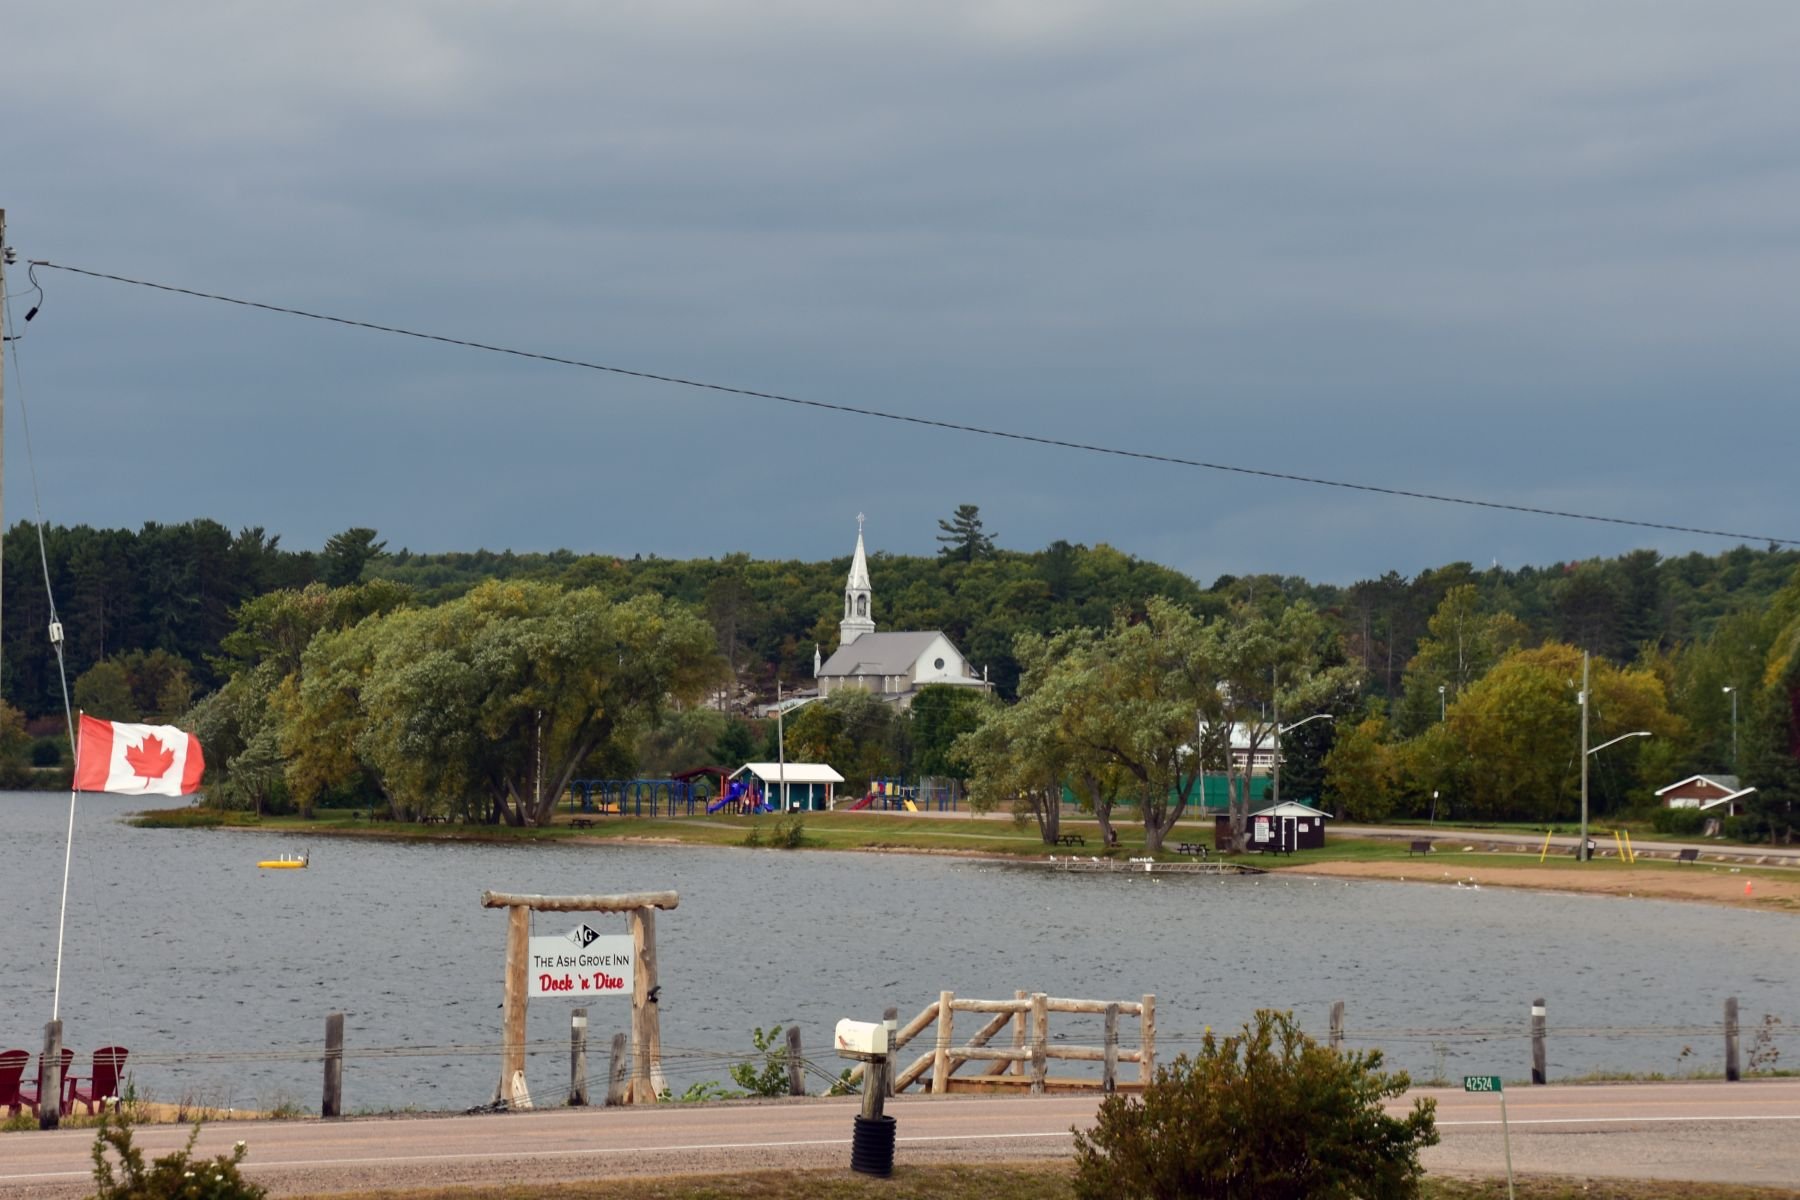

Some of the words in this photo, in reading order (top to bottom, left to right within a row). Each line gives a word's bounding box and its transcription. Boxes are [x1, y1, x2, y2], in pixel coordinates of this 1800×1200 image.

[534, 955, 553, 968] THE
[556, 955, 576, 967] ASH
[579, 954, 611, 967] GROVE
[613, 954, 630, 966] INN
[539, 973, 574, 991] Dock
[593, 972, 624, 990] Dine
[1466, 1077, 1492, 1091] 42524
